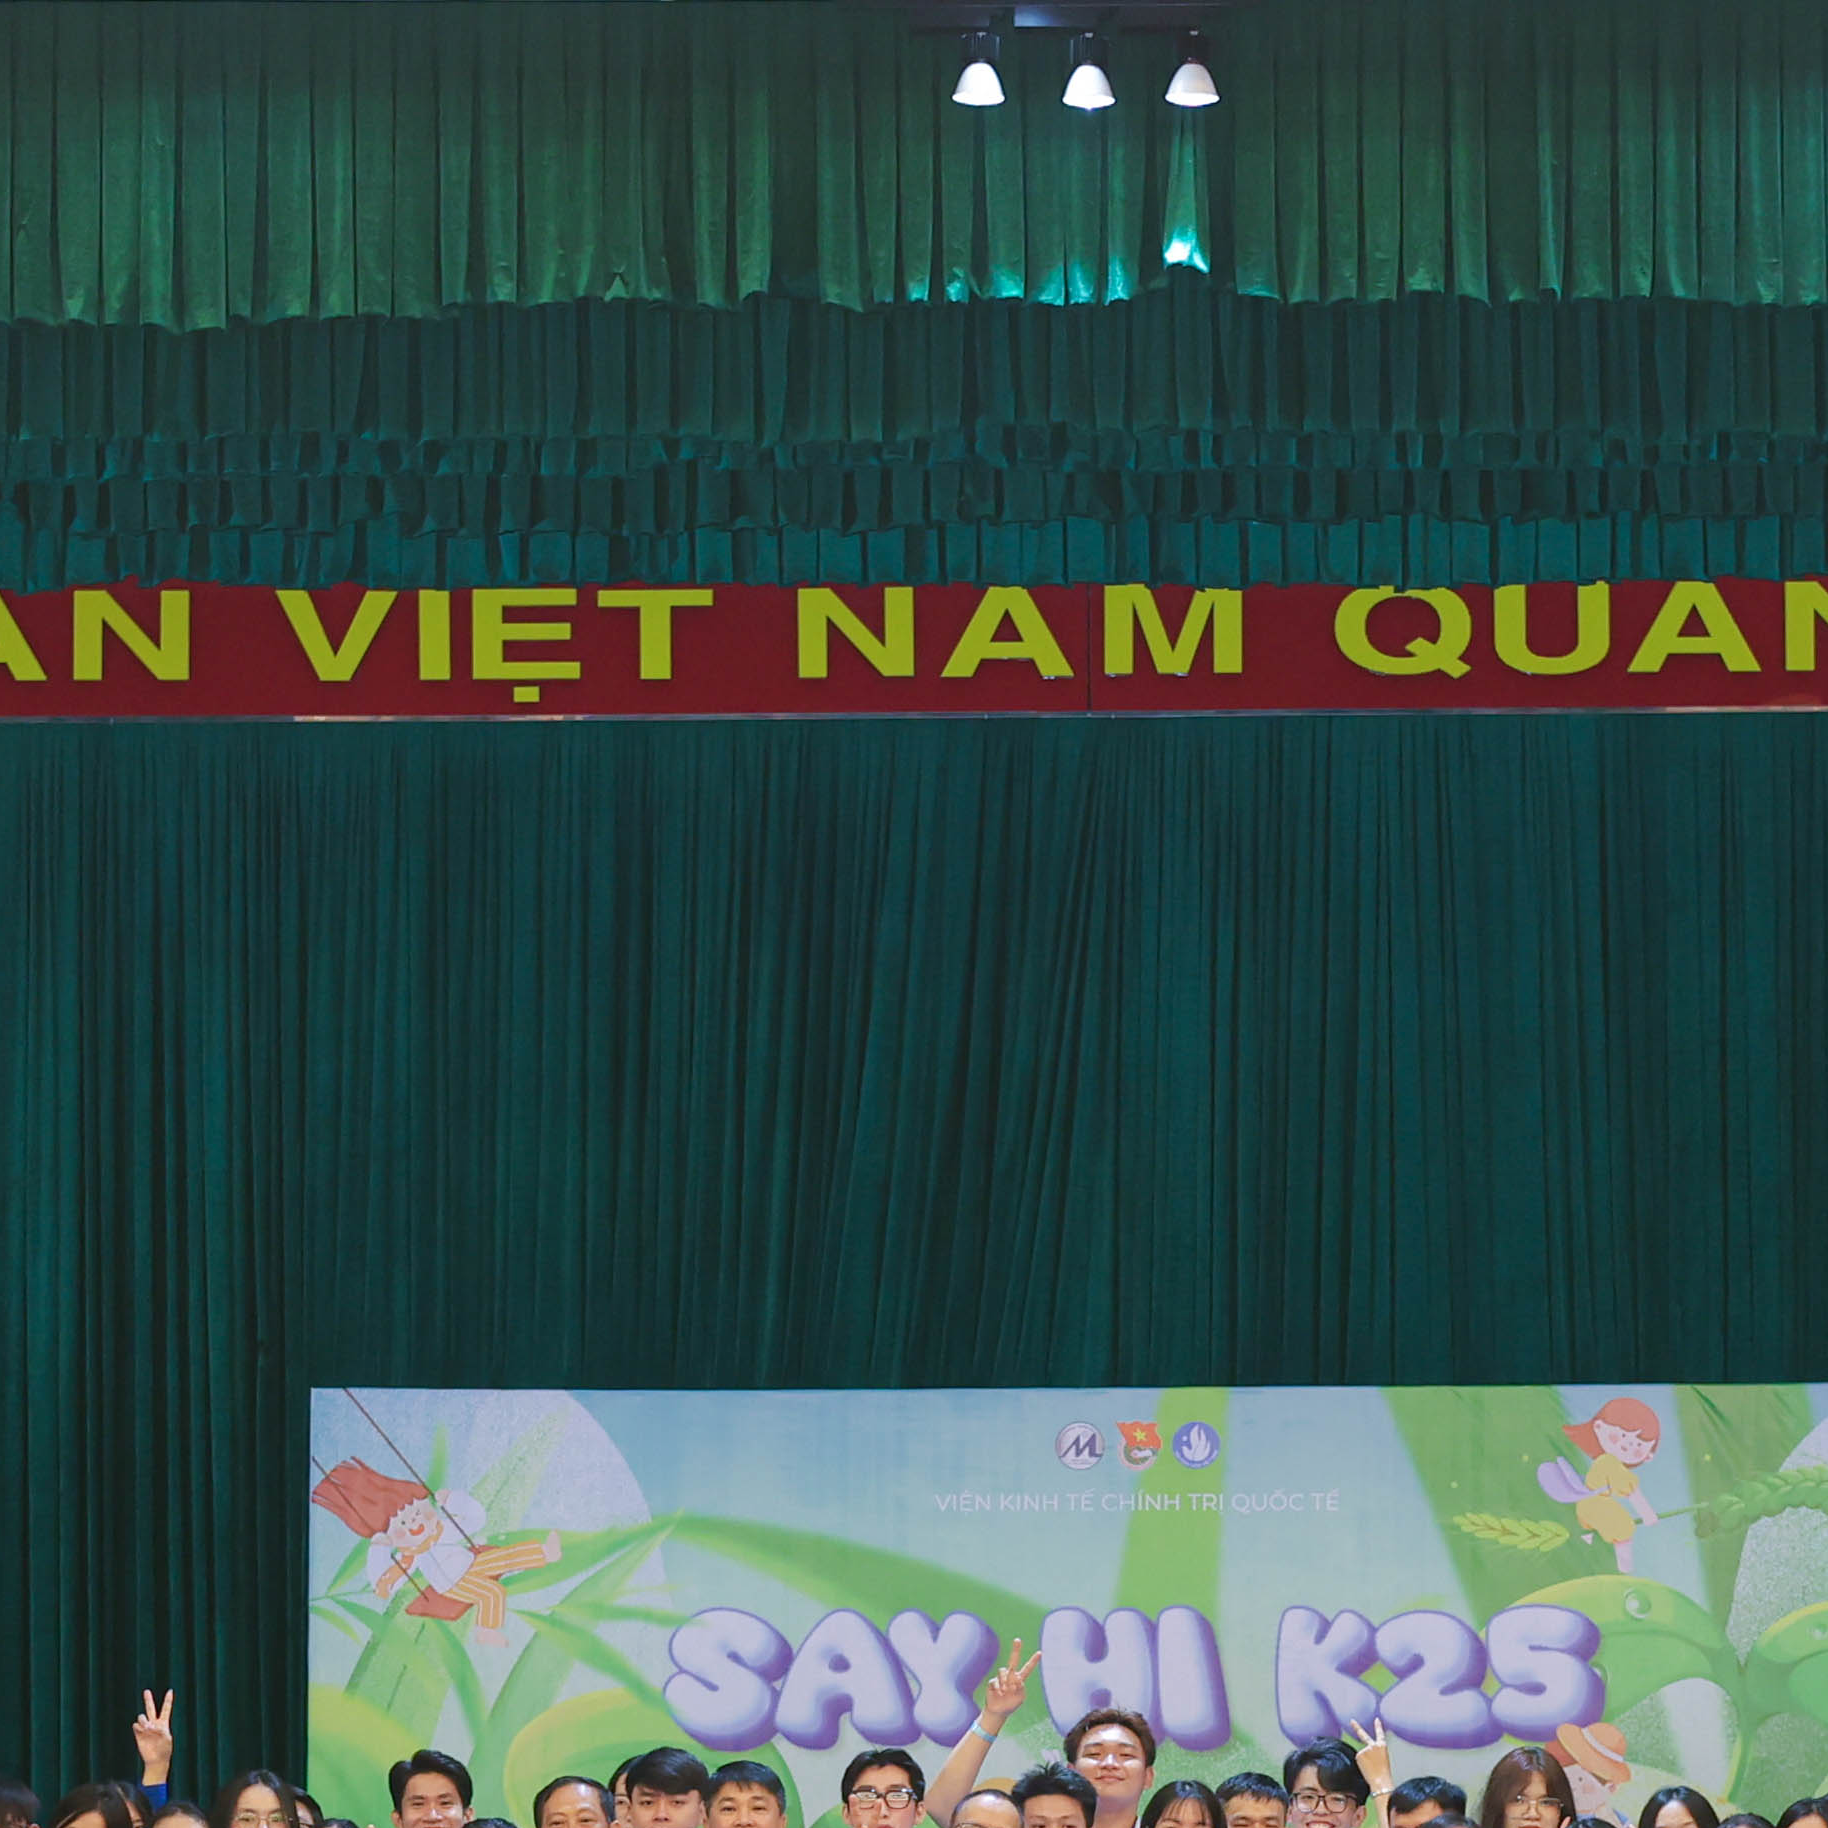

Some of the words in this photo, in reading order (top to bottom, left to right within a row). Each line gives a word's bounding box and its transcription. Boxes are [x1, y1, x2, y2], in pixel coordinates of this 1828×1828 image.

[796, 583, 1244, 679] NAM
[934, 1490, 991, 1515] VIỆN
[999, 1493, 1060, 1512] KINH
[1067, 1488, 1095, 1512] TẾ
[1101, 1489, 1181, 1512] CHÍNH
[1188, 1493, 1224, 1515] TRỊ
[1231, 1488, 1305, 1515] QUỐC
[1310, 1488, 1340, 1512] TẾ
[663, 1606, 1000, 1752] SAY
[1039, 1604, 1231, 1752] HI
[1275, 1604, 1606, 1750] K25
